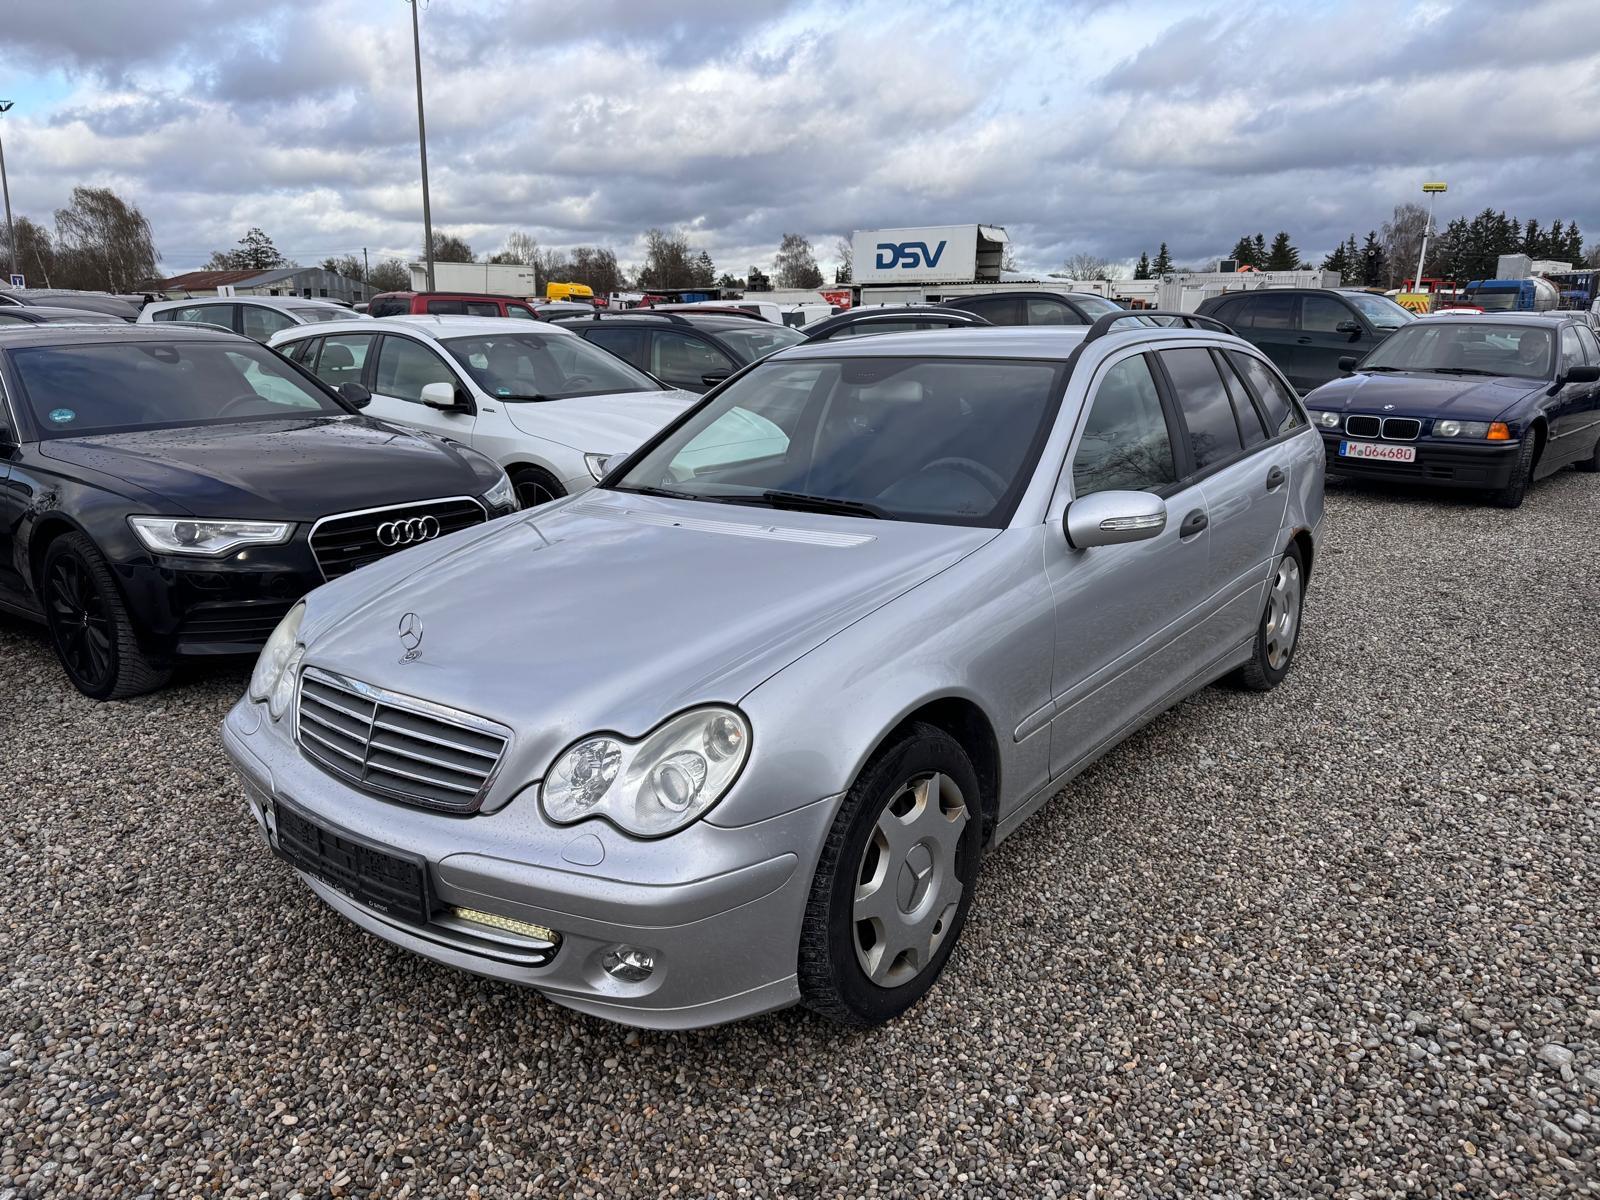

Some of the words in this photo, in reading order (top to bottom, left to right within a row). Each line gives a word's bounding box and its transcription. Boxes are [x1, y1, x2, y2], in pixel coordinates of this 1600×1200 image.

[876, 241, 947, 269] DSV
[1349, 444, 1357, 455] M
[1364, 446, 1412, 460] 064680
